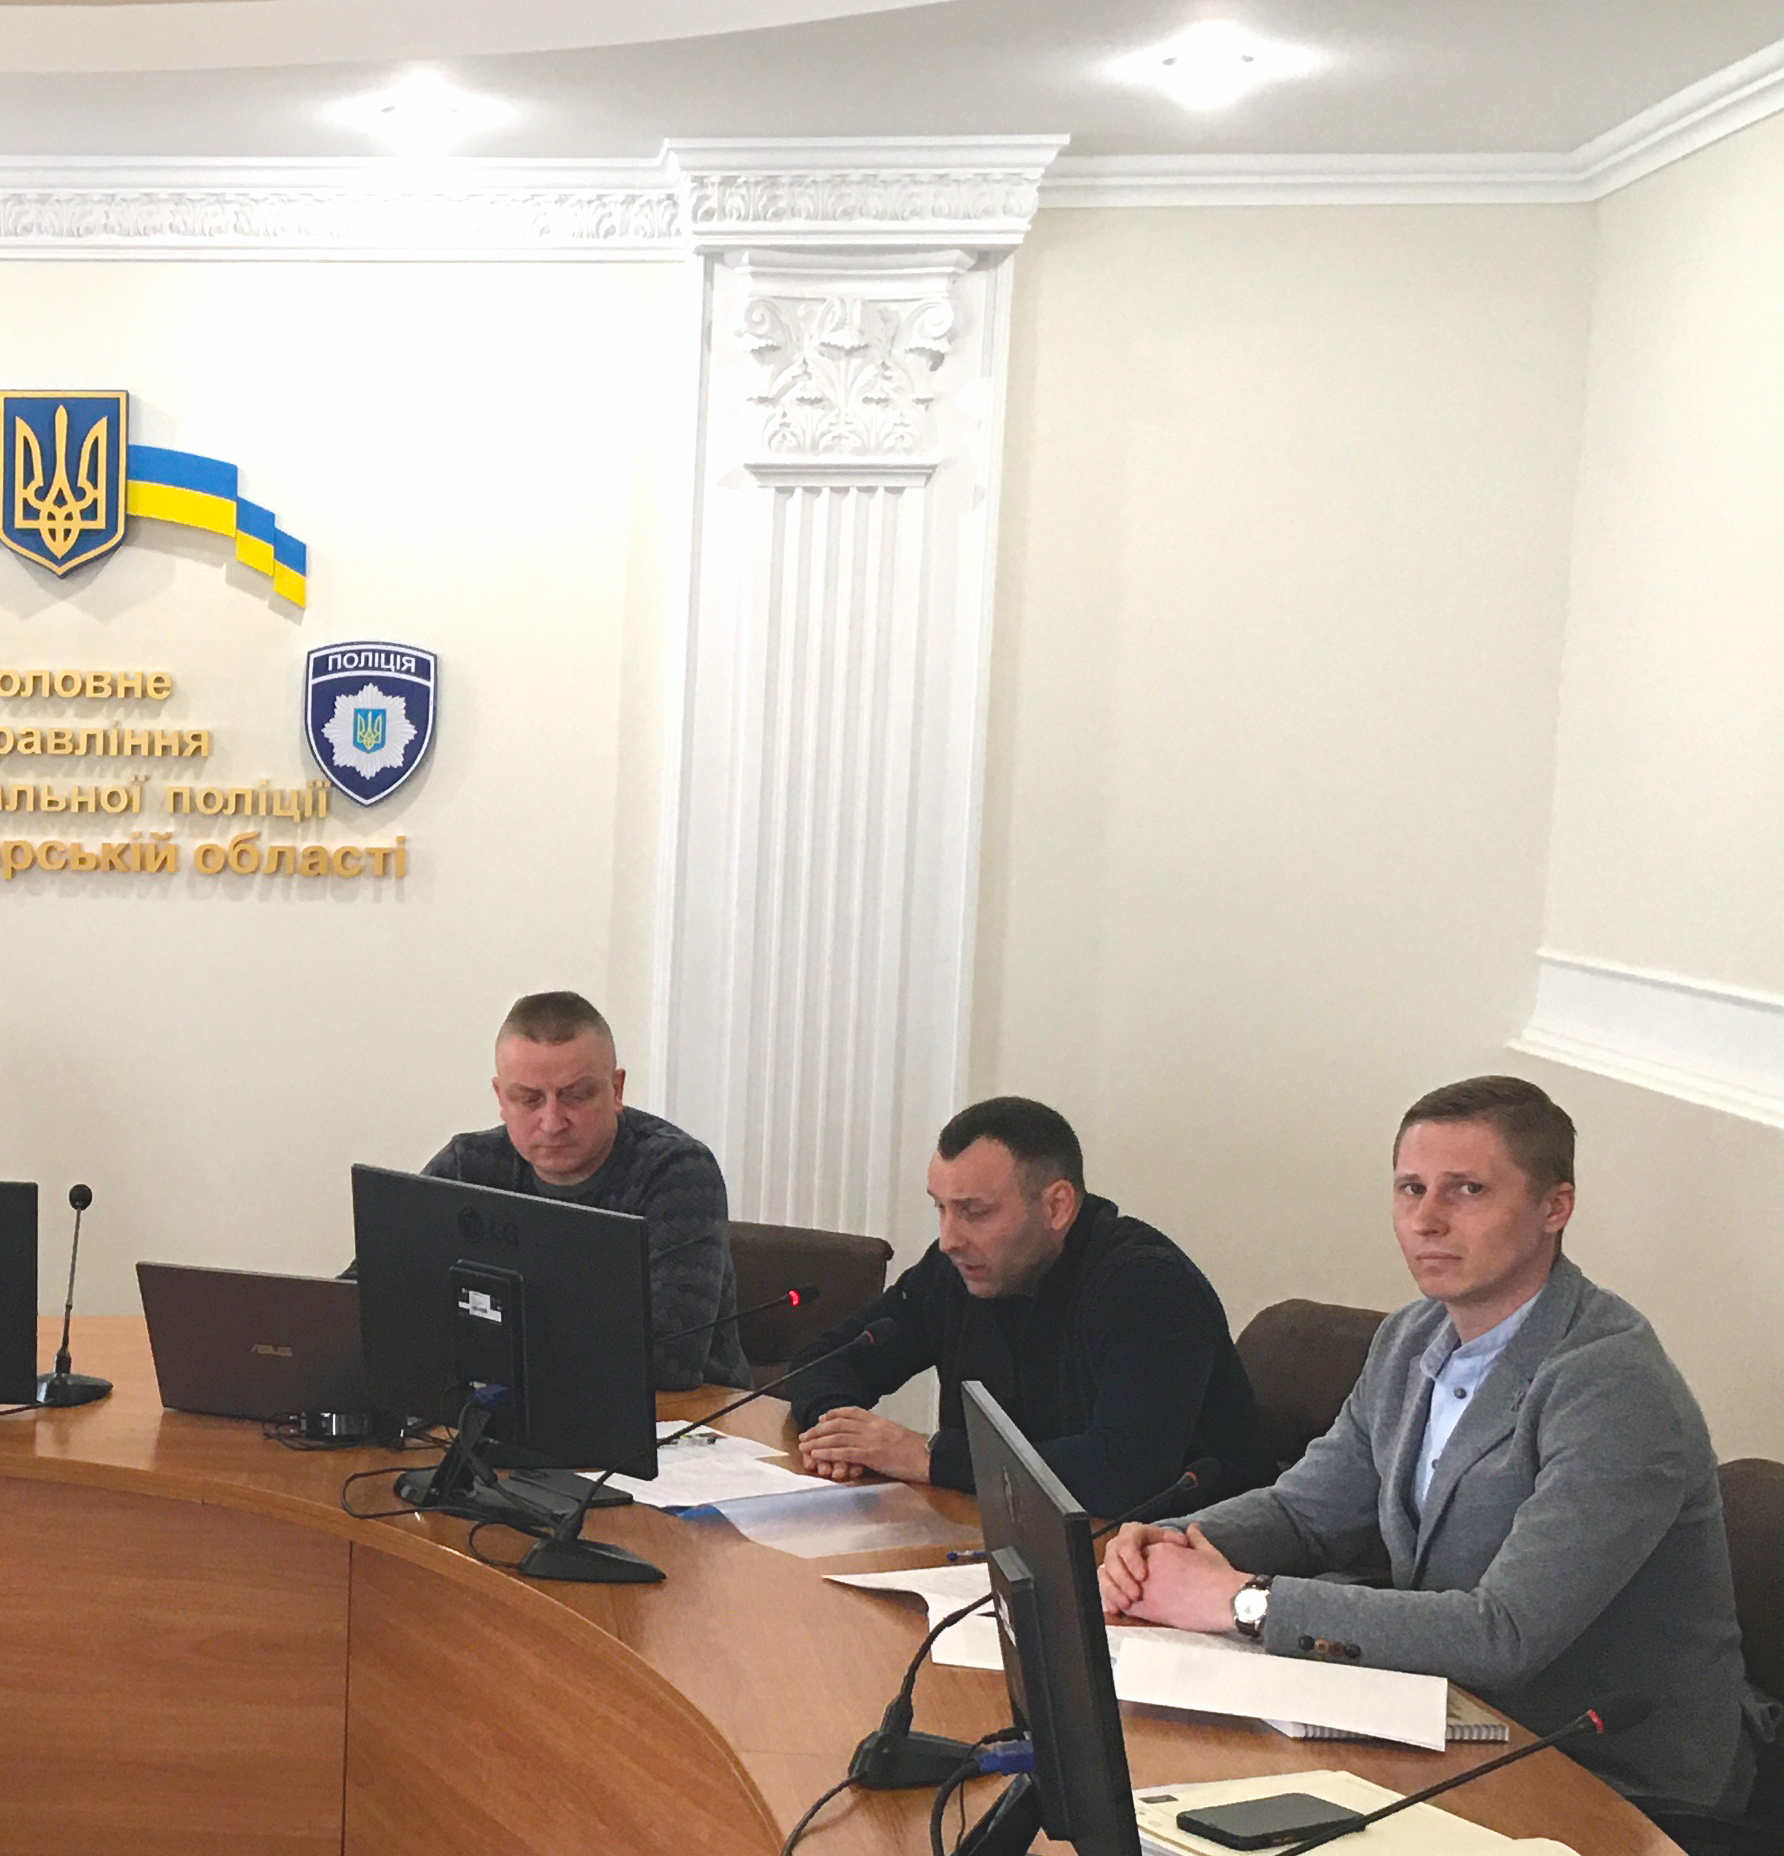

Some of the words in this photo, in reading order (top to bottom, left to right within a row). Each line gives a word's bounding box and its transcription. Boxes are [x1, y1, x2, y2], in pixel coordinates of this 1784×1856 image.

[327, 651, 416, 673] ПОЛІЦІЯ
[168, 778, 333, 823] поліції
[192, 831, 408, 878] області
[488, 1217, 519, 1247] LG
[250, 1343, 293, 1357] ASUS
